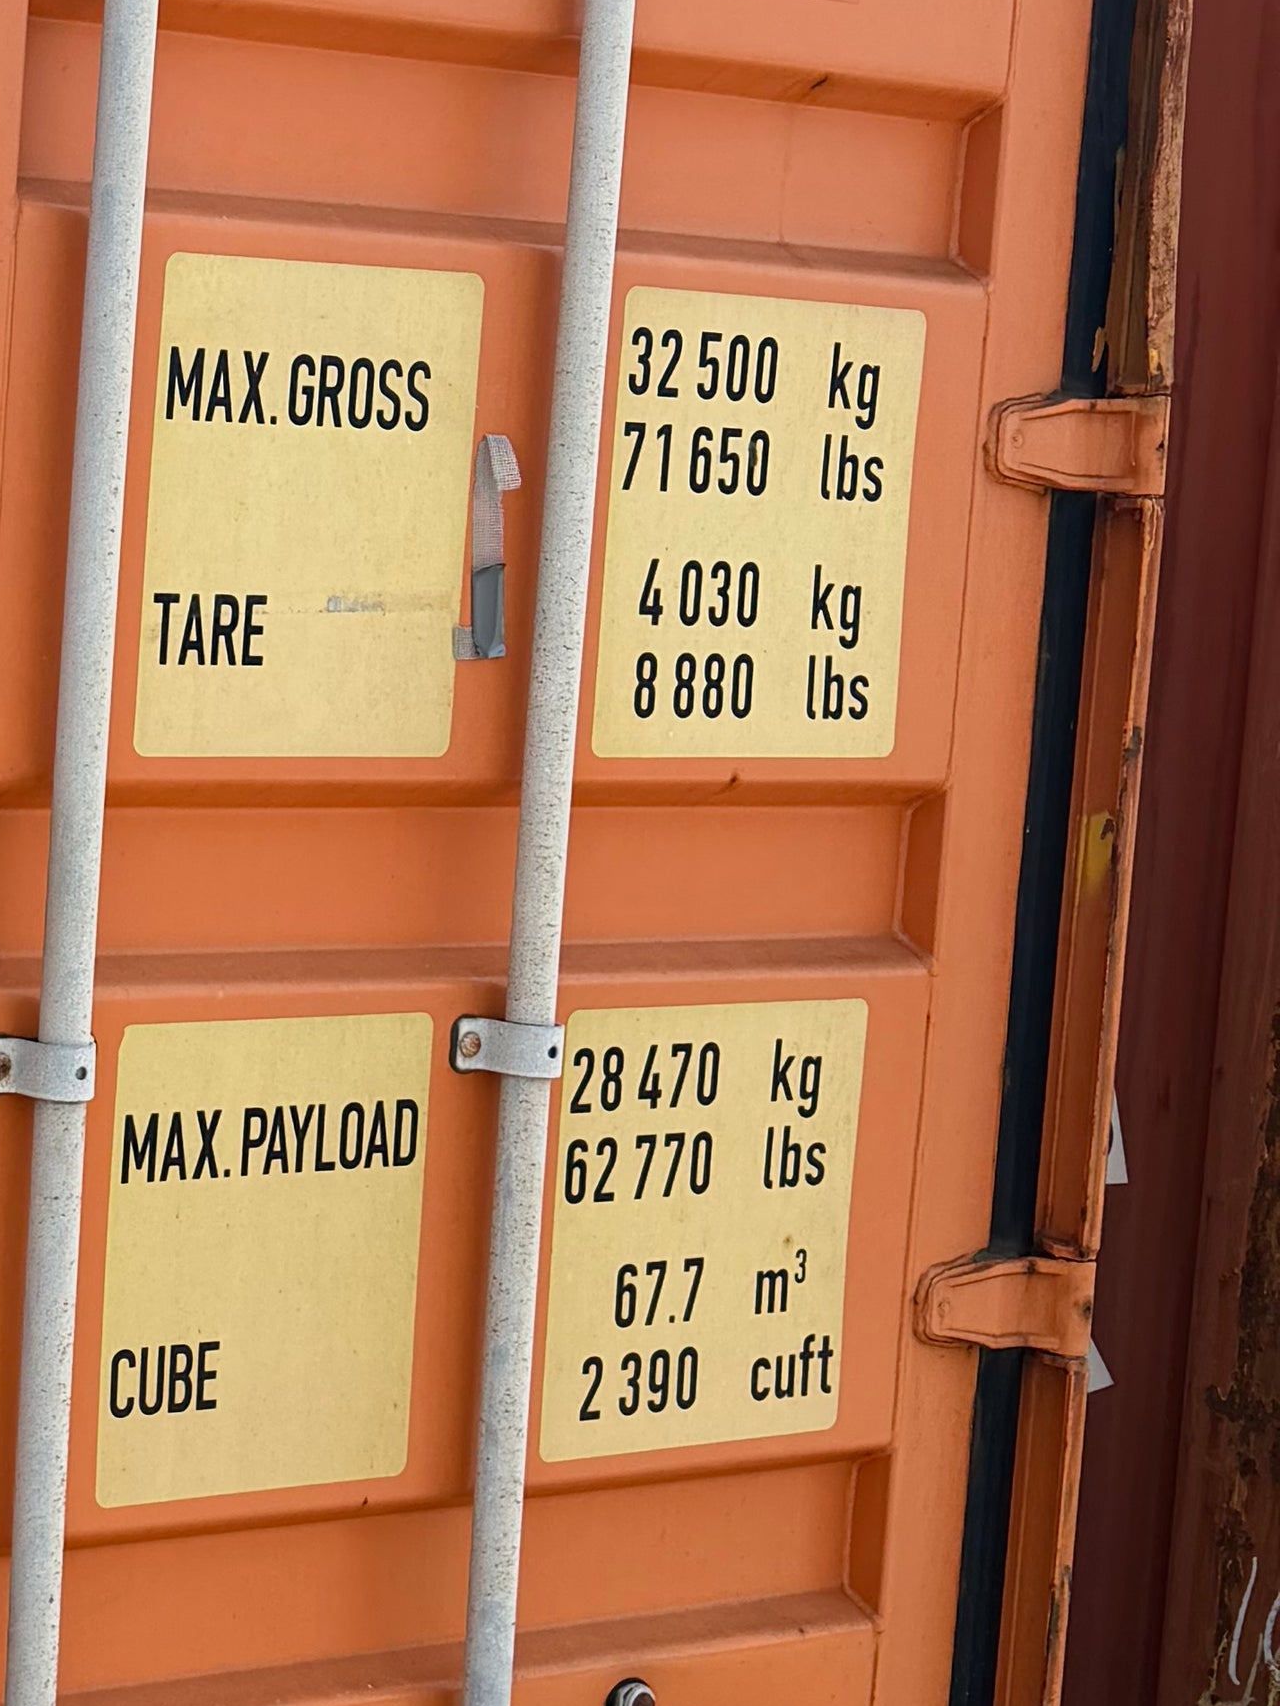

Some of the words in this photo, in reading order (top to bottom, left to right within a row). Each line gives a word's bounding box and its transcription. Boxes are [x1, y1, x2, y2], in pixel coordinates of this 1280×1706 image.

[827, 341, 881, 431] kg
[821, 434, 885, 503] lbs
[152, 591, 269, 668] TARE
[811, 563, 863, 650] kg
[805, 653, 872, 722] lbs
[770, 1037, 824, 1119] kg
[762, 1124, 829, 1192] lbs
[613, 1256, 707, 1330] 67.7
[109, 1339, 223, 1420] CUBE
[749, 1334, 836, 1403] cuft
